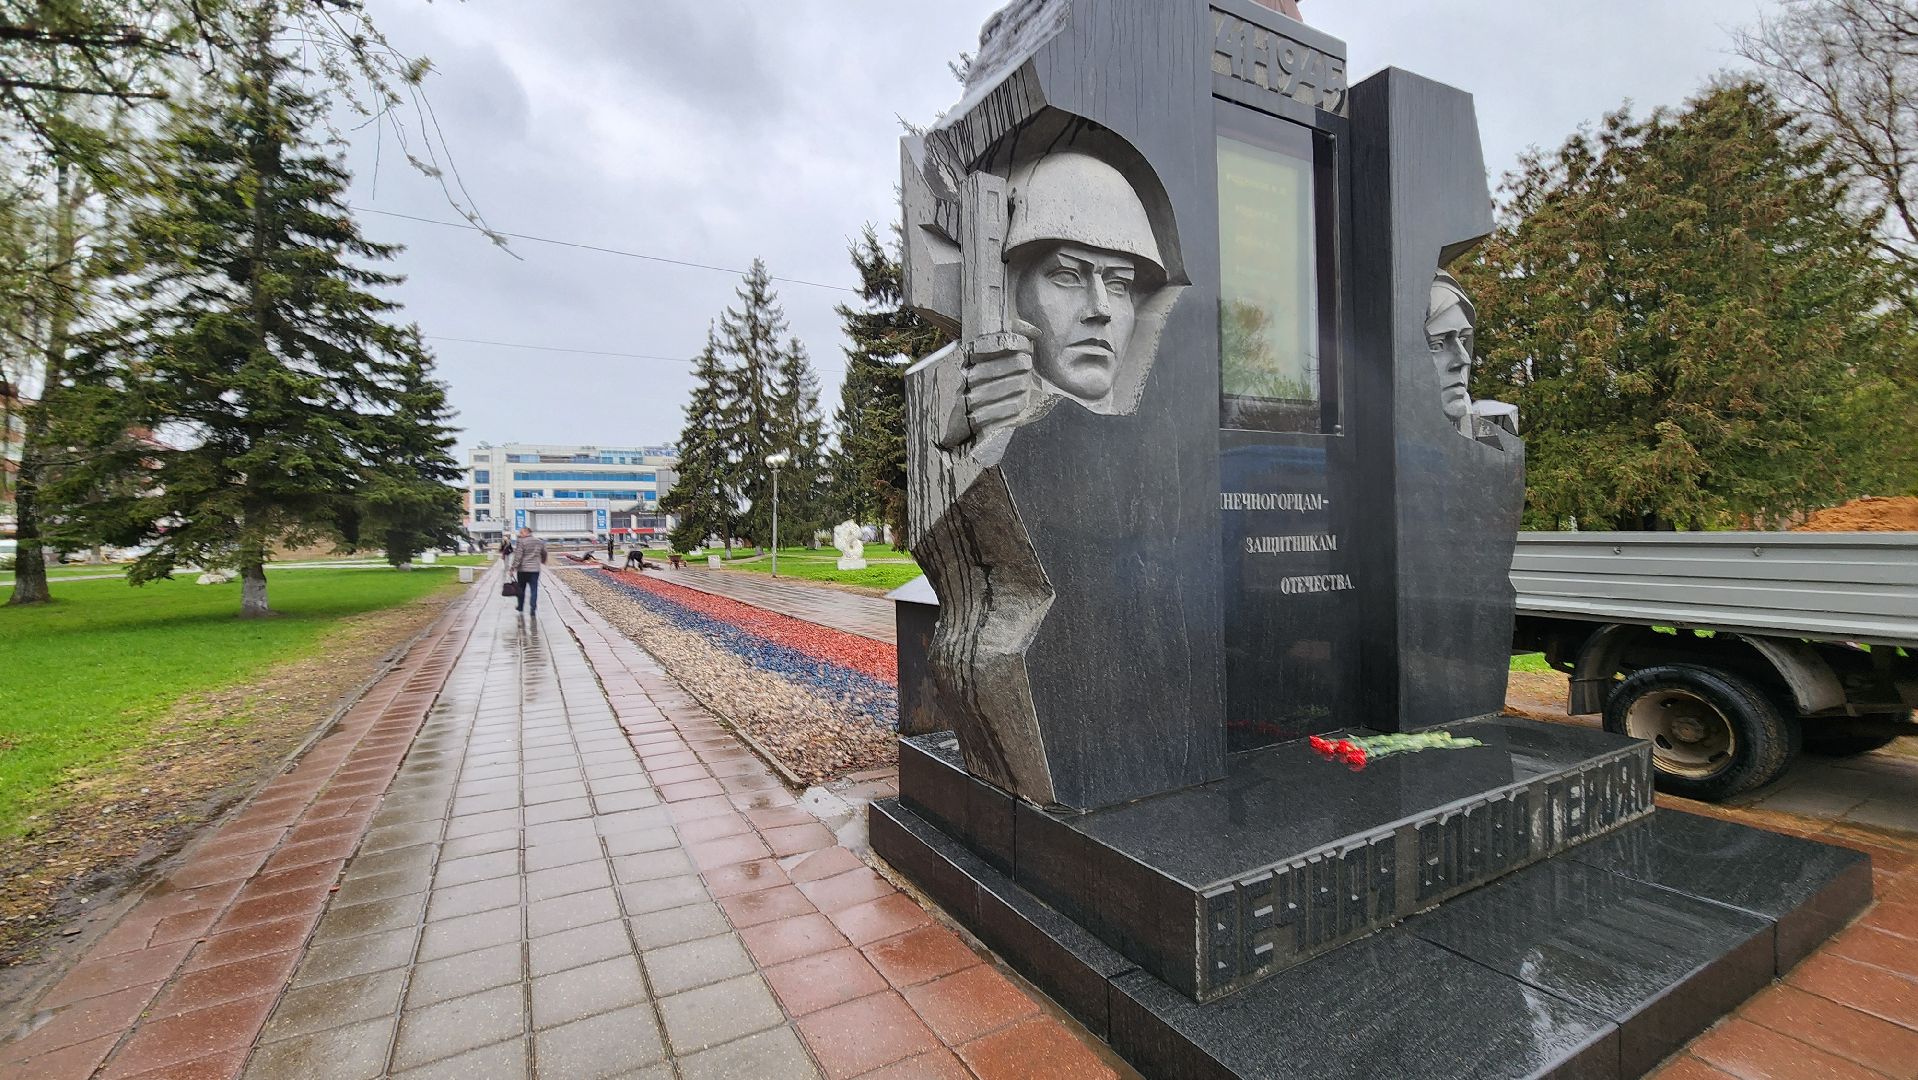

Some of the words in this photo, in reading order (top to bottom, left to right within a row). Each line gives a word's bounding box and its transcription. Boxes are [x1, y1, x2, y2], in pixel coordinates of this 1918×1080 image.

[1220, 492, 1330, 513] НЕЧНОГОРЦАМ-
[1245, 534, 1338, 556] ЗАЩИТНИКАМ
[1202, 831, 1397, 991] ВЕЧНАЯ
[1414, 785, 1530, 903] СЛАВА
[1544, 748, 1652, 855] ГЕРОЯМ
